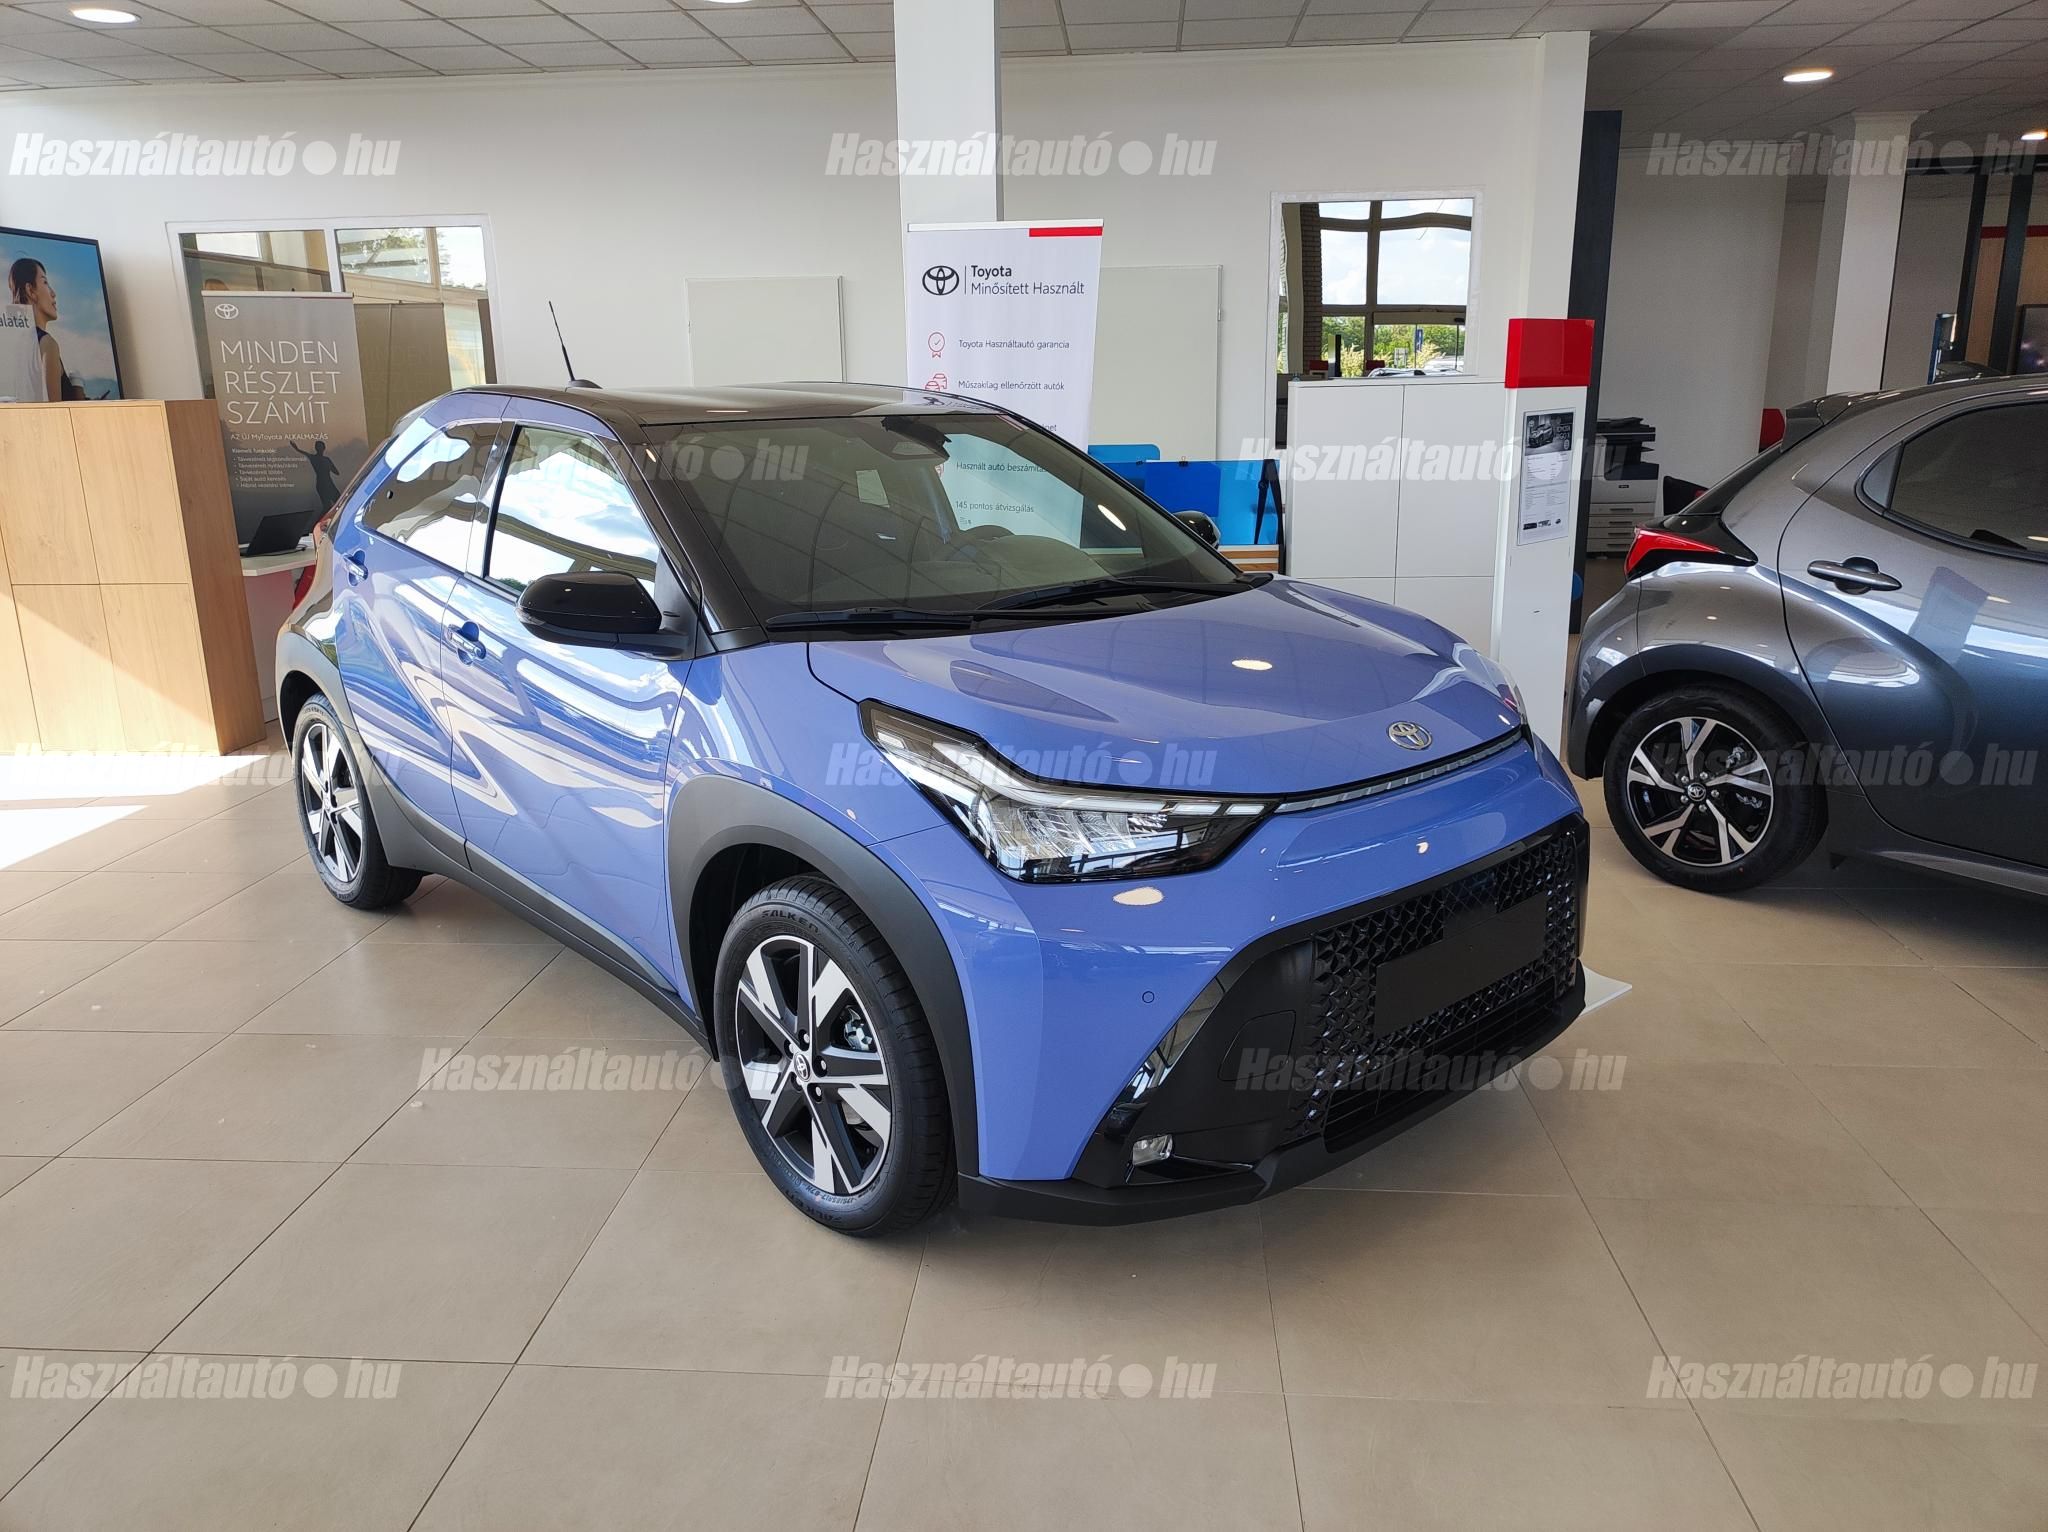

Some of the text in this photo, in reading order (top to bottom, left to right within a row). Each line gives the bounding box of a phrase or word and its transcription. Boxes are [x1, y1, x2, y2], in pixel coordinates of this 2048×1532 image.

[971, 265, 1012, 280] Toyota
[971, 281, 1085, 295] Minősített Használt
[959, 339, 1070, 350] Toyota Használtautó garancia
[220, 340, 338, 364] MINDEN
[224, 364, 341, 394] RÉSZLET
[1044, 381, 1065, 390] autók
[227, 394, 329, 424] SZÁMÍT
[284, 432, 329, 440] ALKALMAZÁS
[956, 462, 986, 470] Használt
[988, 463, 1005, 471] autó
[956, 501, 1034, 513] 145 pontos átvizsgálás
